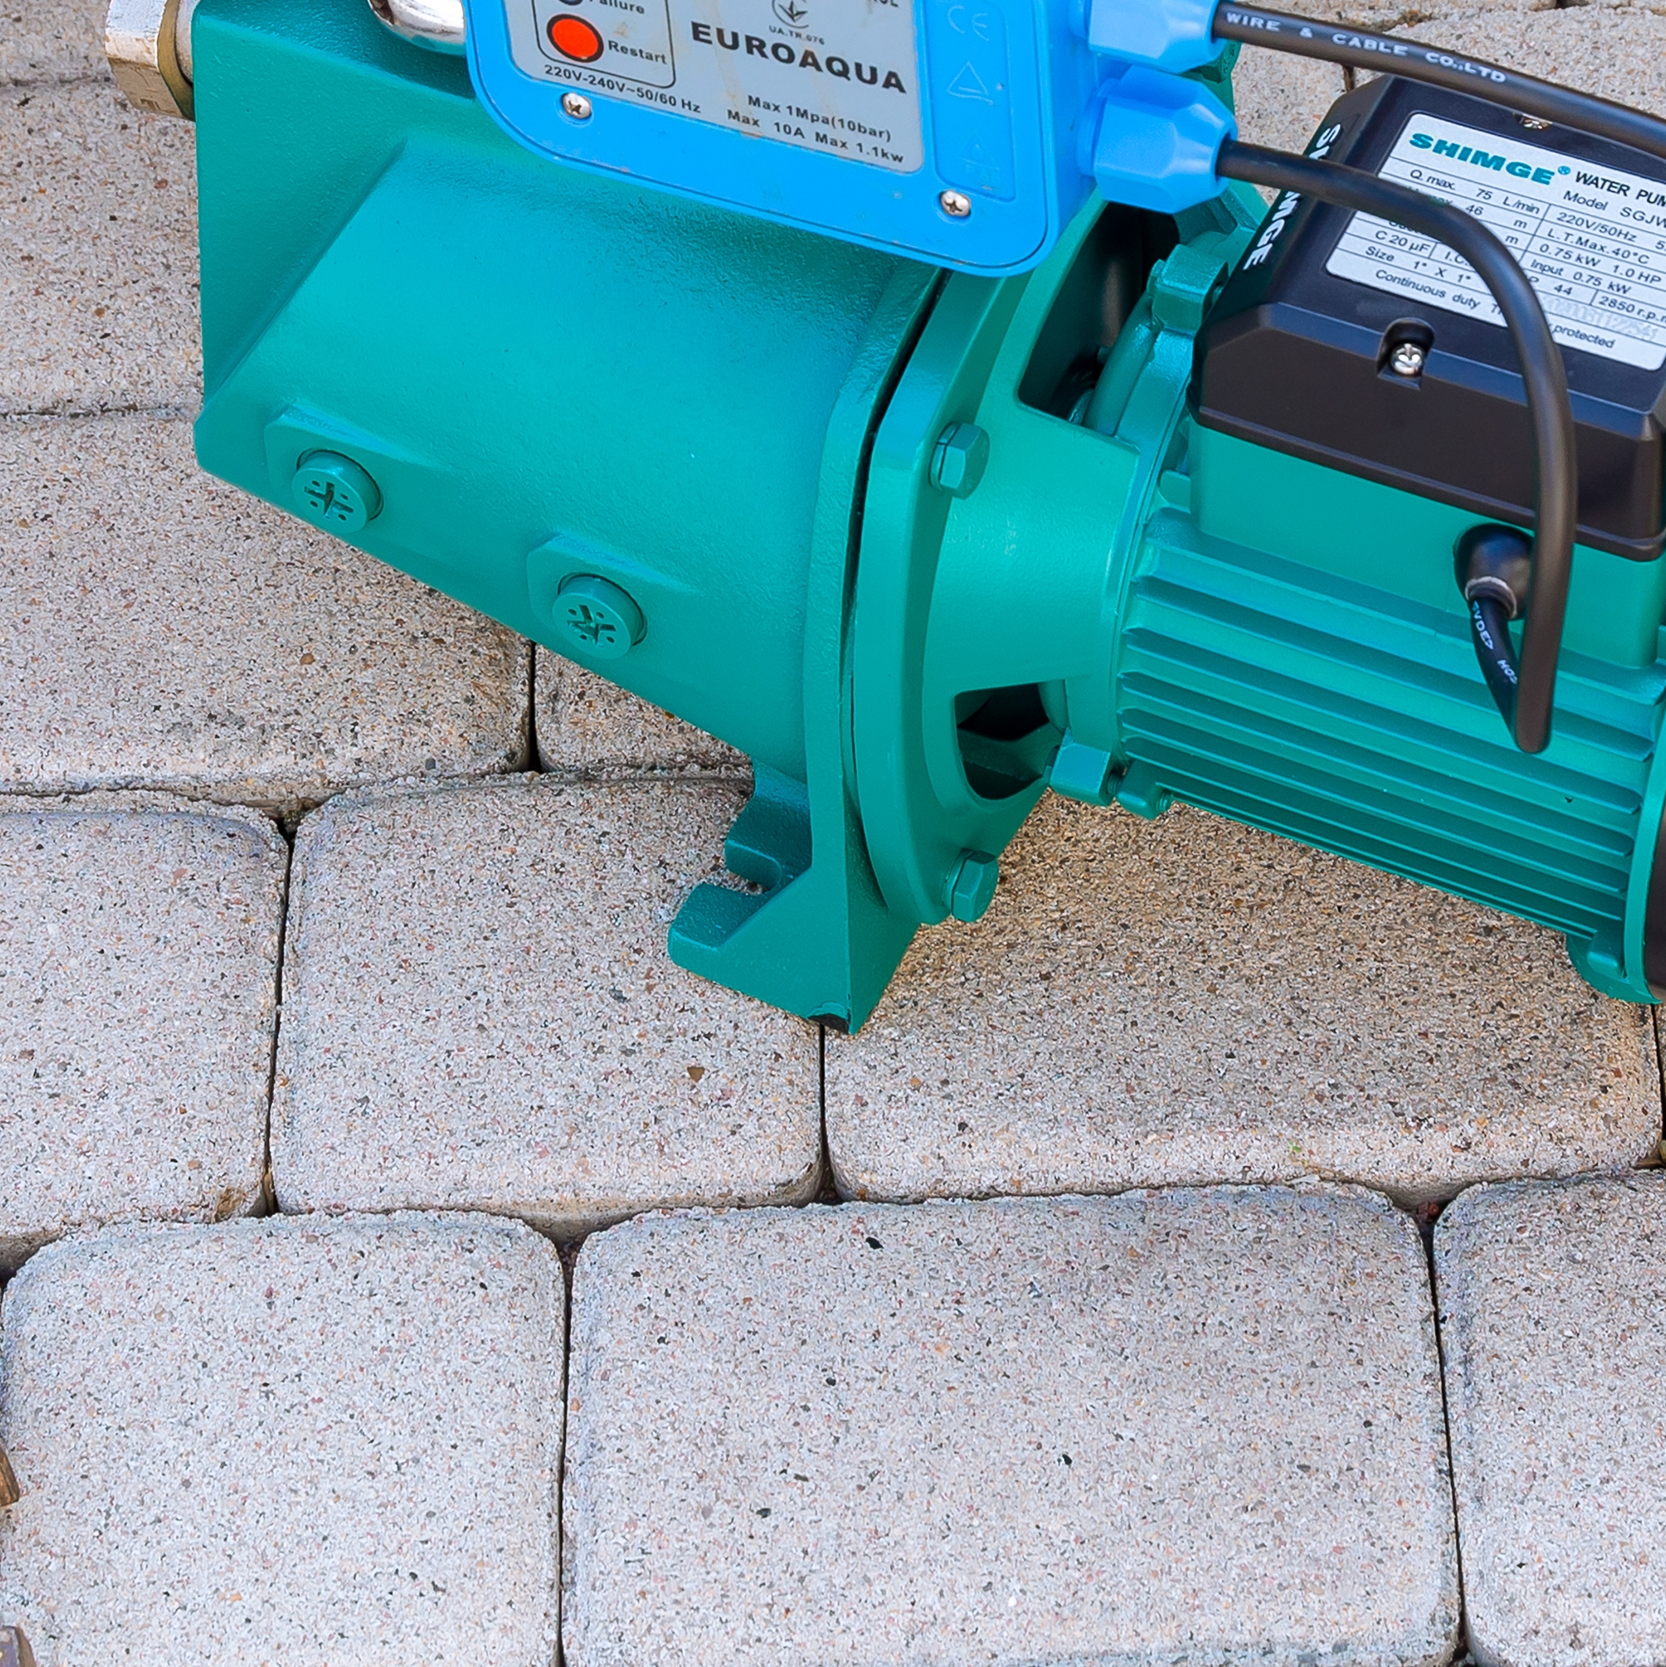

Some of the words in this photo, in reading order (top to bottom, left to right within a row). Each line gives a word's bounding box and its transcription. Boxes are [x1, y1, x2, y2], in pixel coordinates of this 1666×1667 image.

[1226, 12, 1281, 32] WIRE
[1299, 26, 1313, 39] &
[1332, 33, 1409, 56] CABLE
[608, 40, 668, 65] Restart
[691, 21, 907, 94] EUROAQUA
[544, 64, 677, 108] 220V-240V~50/60
[681, 98, 702, 114] Hz
[747, 95, 781, 113] Max
[786, 105, 892, 143] 1Mpa(10bar)
[727, 109, 760, 128] Max
[774, 121, 806, 139] 10A
[815, 131, 849, 150] Max
[856, 142, 904, 164] 1.1kw
[1242, 123, 1342, 270] SMGE
[1476, 188, 1493, 201] 75
[1575, 171, 1631, 197] WATER
[1563, 190, 1609, 212] Model
[1465, 204, 1484, 216] 46
[1513, 218, 1528, 229] m
[1556, 211, 1638, 243] 220V/50Hz
[1375, 230, 1388, 240] C
[1389, 234, 1408, 247] 20
[1504, 234, 1519, 245] m
[1365, 245, 1395, 263] Size
[1539, 243, 1573, 261] 0.75
[1575, 254, 1601, 268] kW
[1612, 264, 1635, 279] 1.0
[1637, 272, 1662, 285] HP
[1375, 269, 1447, 299] Continuous
[1452, 293, 1481, 310] duty
[1530, 259, 1564, 276] Input
[1573, 271, 1603, 287] 0.75
[1607, 280, 1632, 295] kW
[1554, 284, 1573, 295] 44
[1598, 295, 1636, 314] 2850
[1552, 324, 1616, 349] protected
